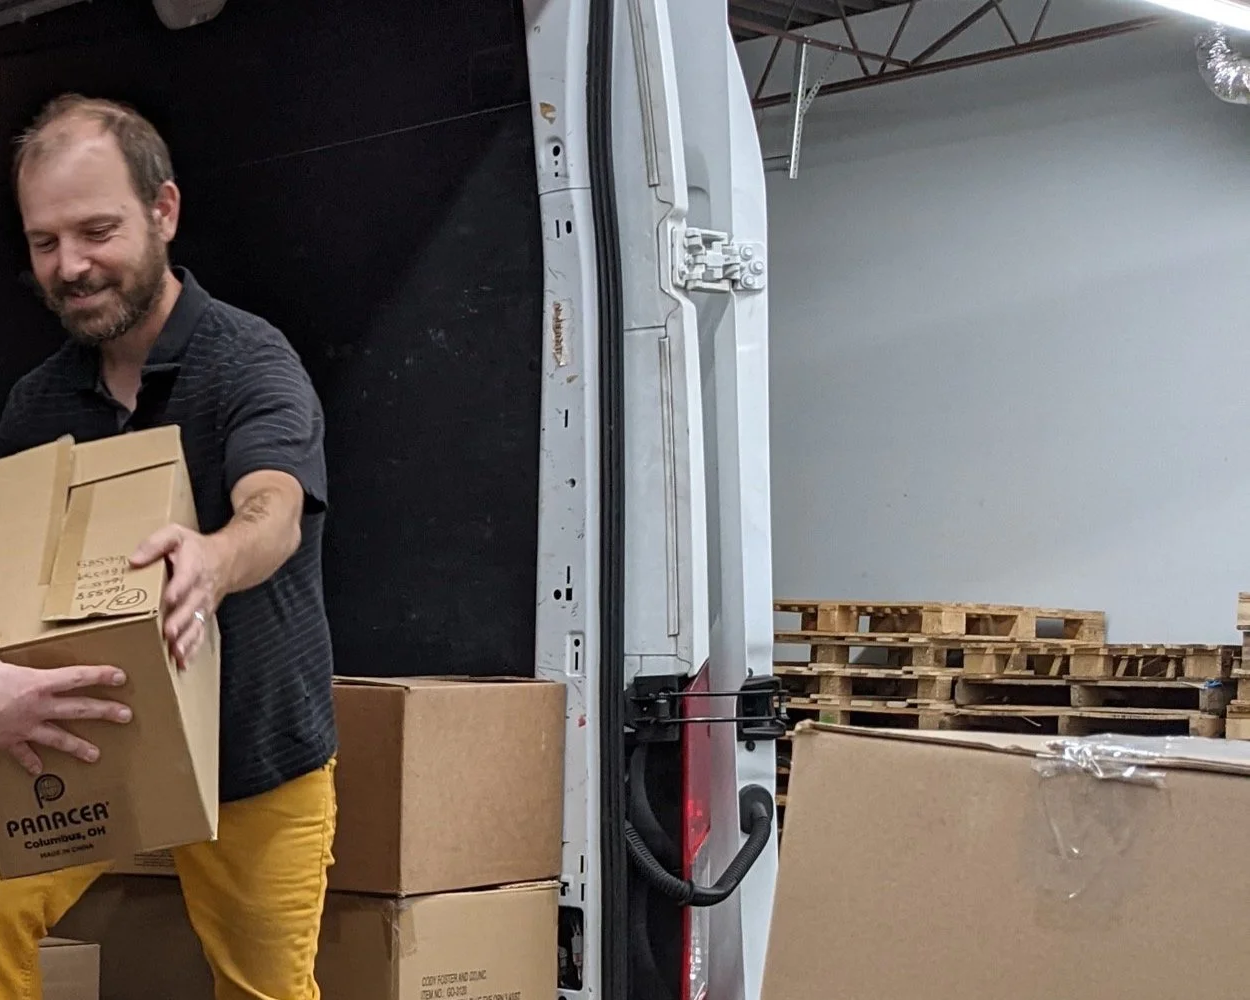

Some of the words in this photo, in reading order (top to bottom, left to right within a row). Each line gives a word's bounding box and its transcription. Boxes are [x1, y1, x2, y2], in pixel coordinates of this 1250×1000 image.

[6, 802, 109, 837] PANACEA
[24, 831, 86, 849] Columbus,
[87, 826, 106, 838] OH
